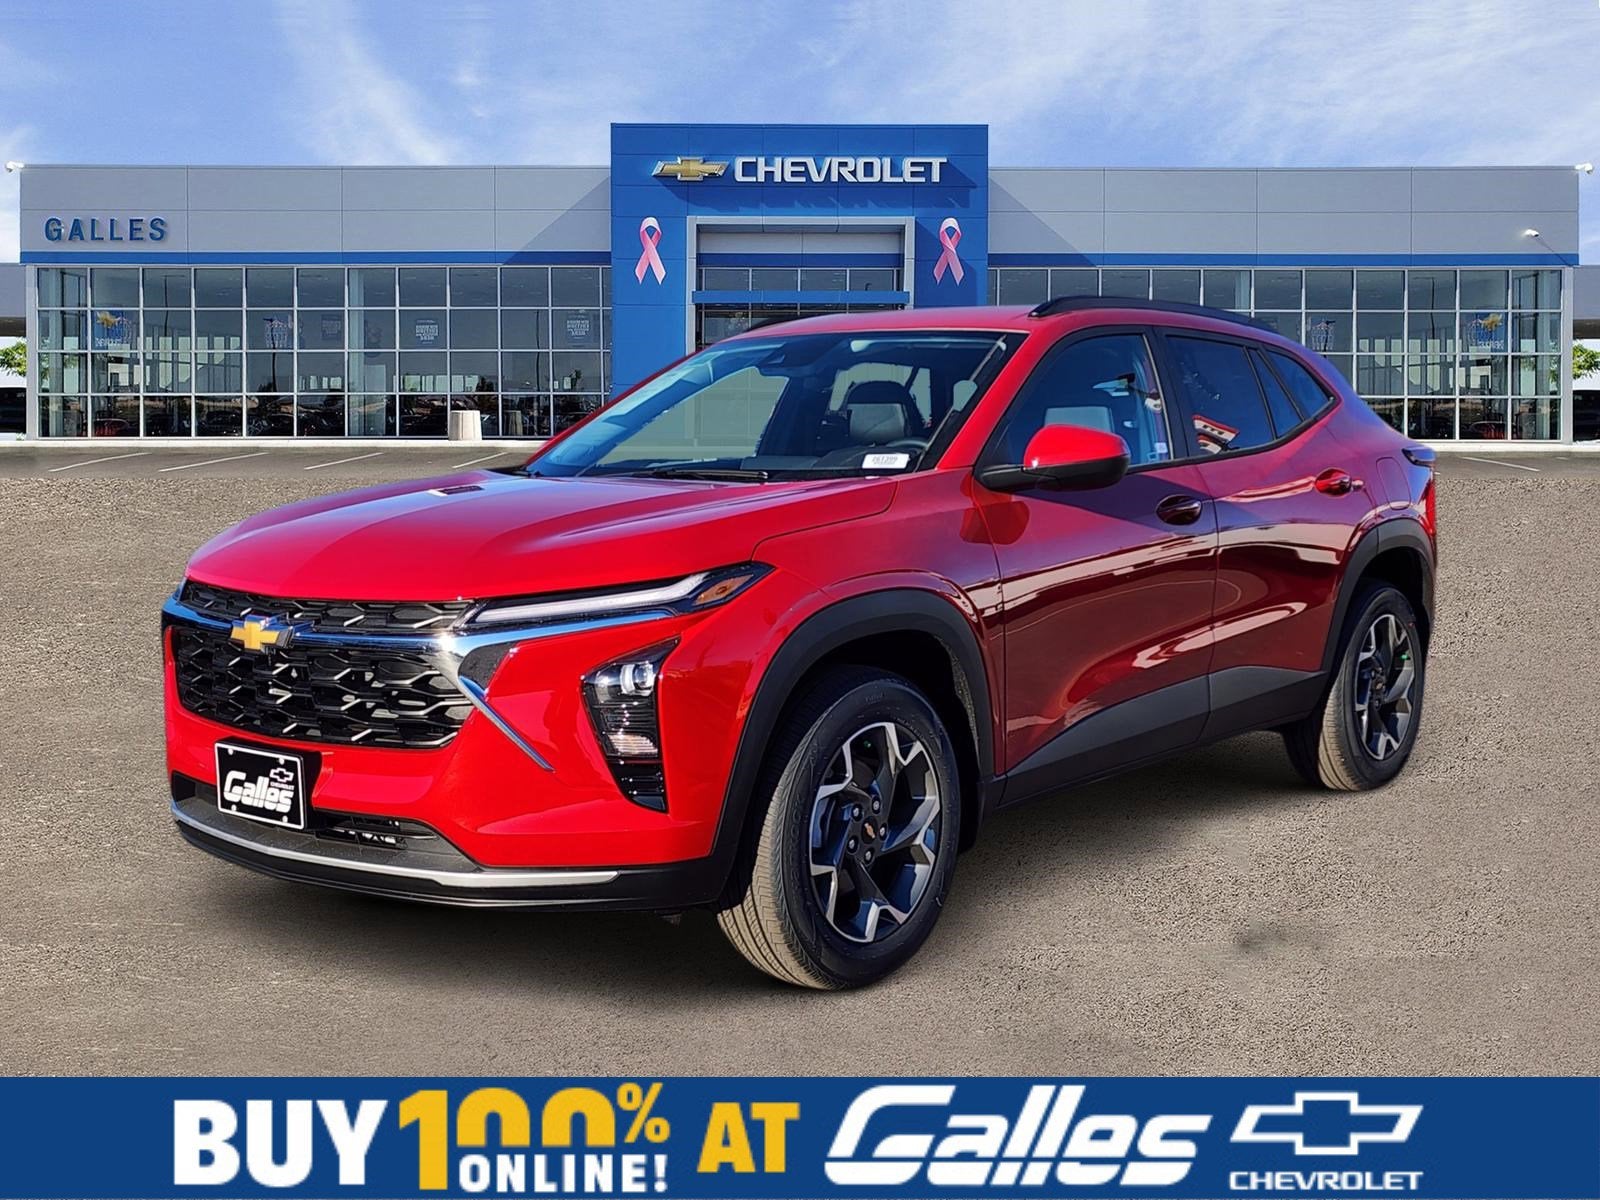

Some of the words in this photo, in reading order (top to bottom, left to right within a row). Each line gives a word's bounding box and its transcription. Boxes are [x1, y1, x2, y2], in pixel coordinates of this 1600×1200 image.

[733, 156, 948, 183] CHEVROLET
[44, 217, 168, 242] GALLES
[223, 770, 294, 813] Galles
